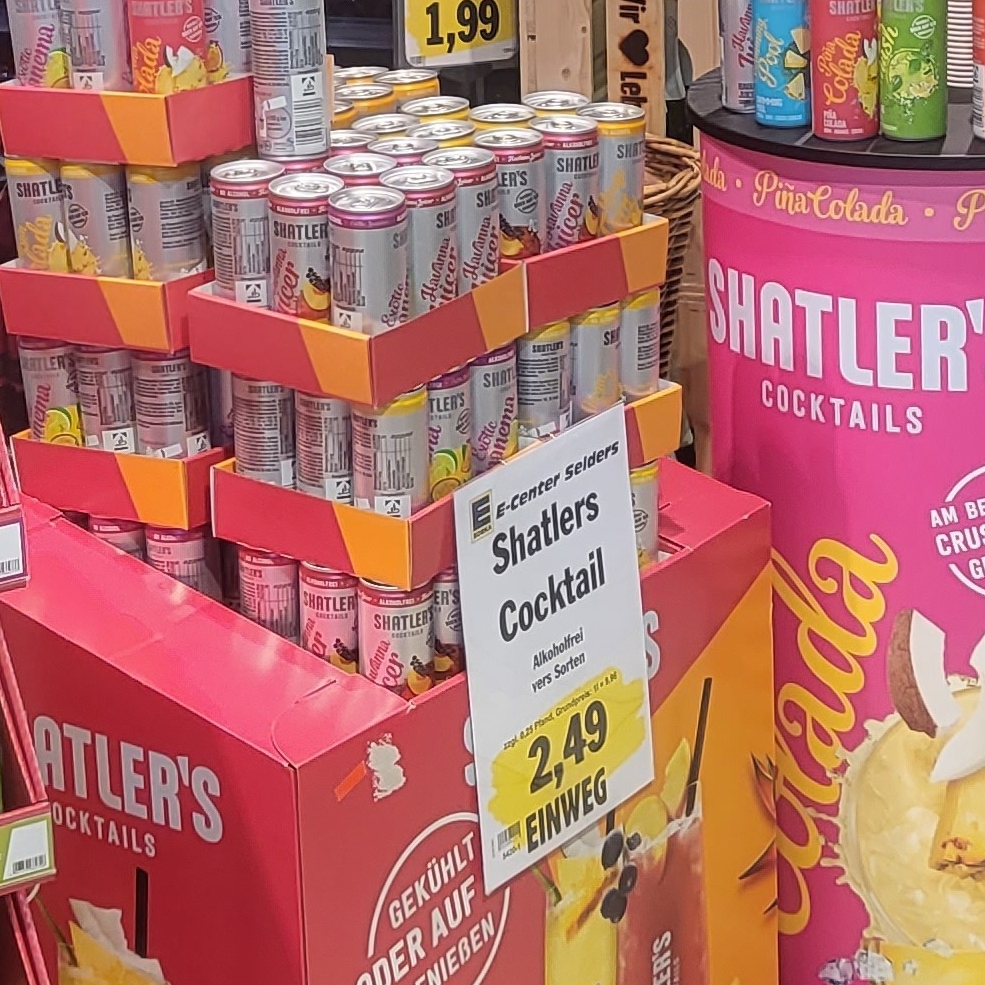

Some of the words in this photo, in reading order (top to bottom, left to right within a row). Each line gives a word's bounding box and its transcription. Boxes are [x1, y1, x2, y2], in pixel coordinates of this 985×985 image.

[823, 30, 862, 106] Colada
[556, 153, 599, 172] SHATLE
[760, 379, 924, 435] COCKTAILS
[495, 472, 561, 520] E-Center
[564, 441, 619, 481] Selders
[930, 505, 957, 528] AM
[492, 492, 600, 575] Shatlers
[498, 546, 606, 642] Cocktail
[531, 672, 552, 693] vers
[554, 652, 586, 679] Sorten
[533, 627, 584, 670] Alkoholfrei
[33, 715, 223, 843] ATLER'S
[527, 699, 608, 795] 2,49
[52, 801, 156, 857] OCKTAILS
[525, 766, 608, 854] EINWEG
[387, 831, 476, 930] GEKÜHLT
[430, 876, 476, 948] AUF
[414, 911, 495, 985] ENIEßEN
